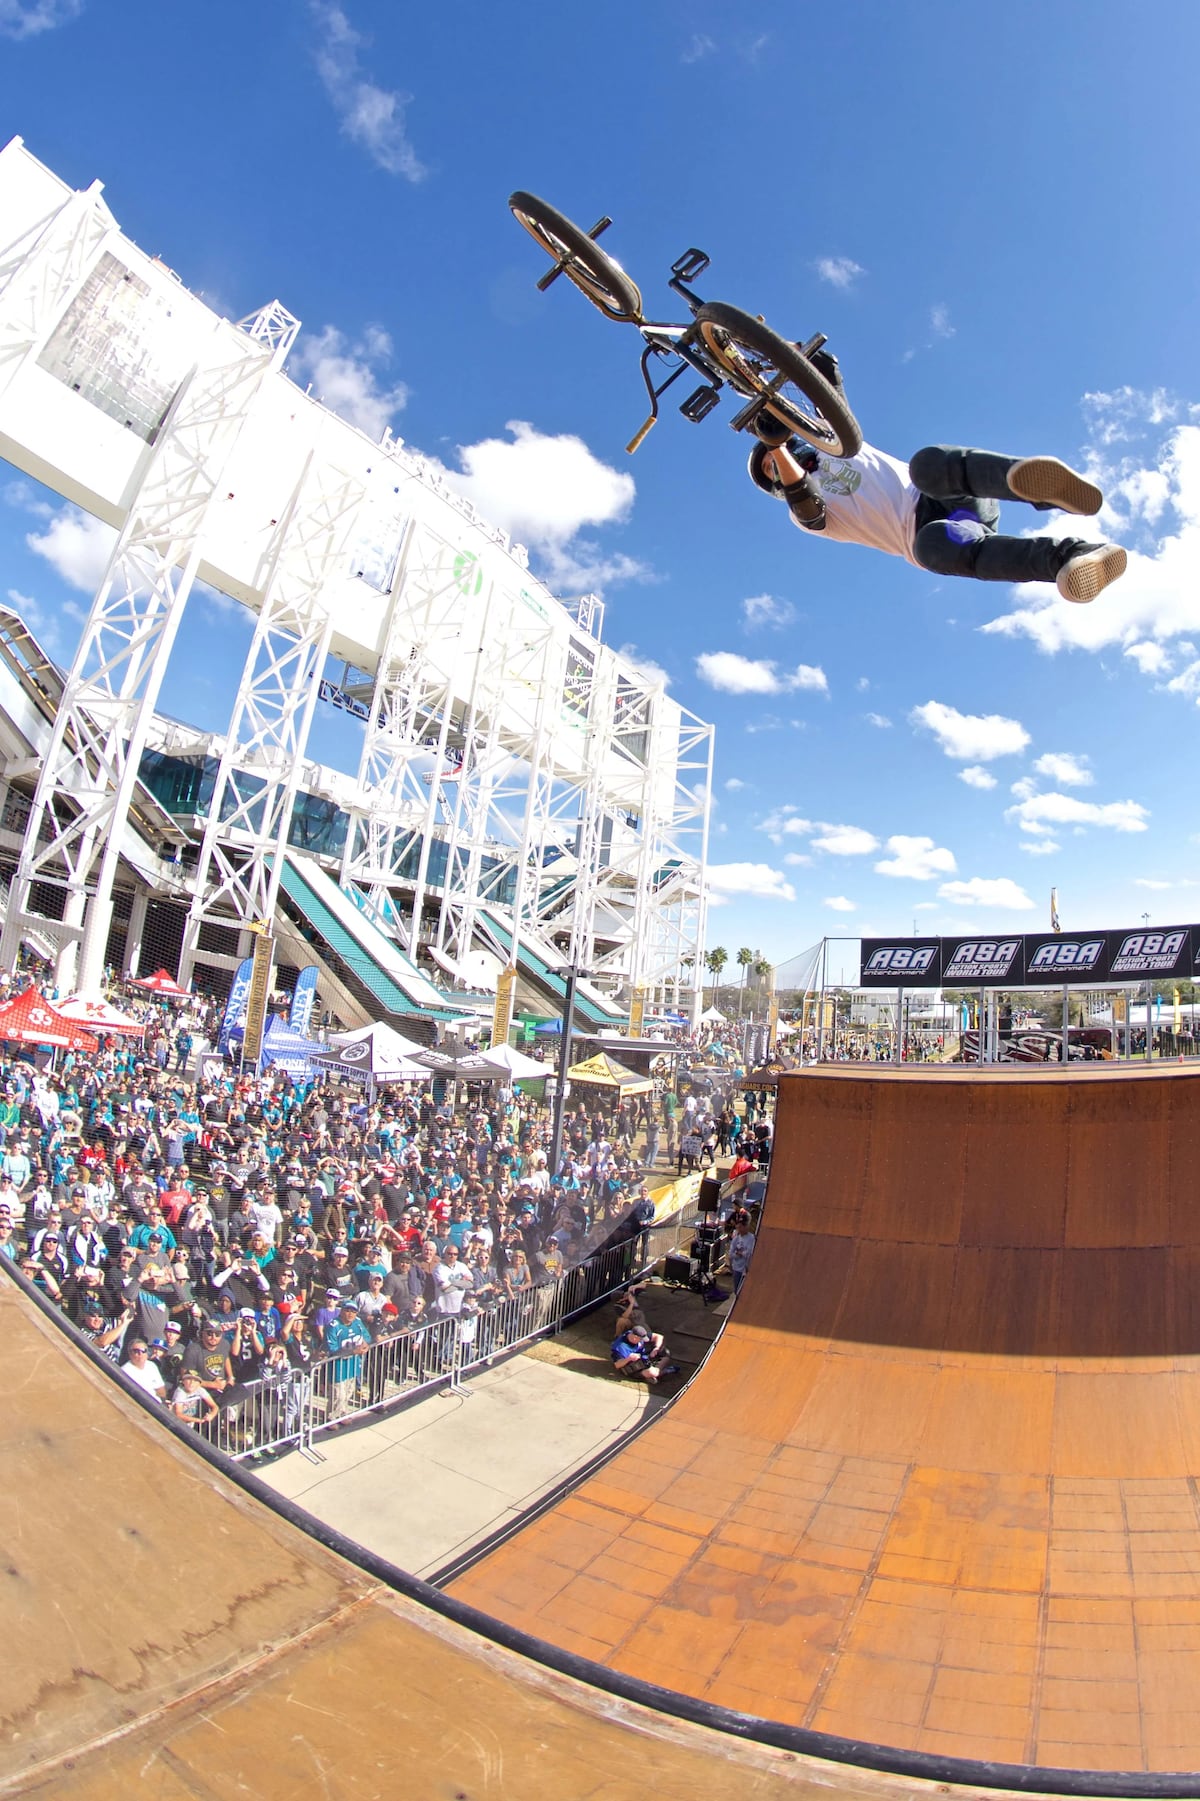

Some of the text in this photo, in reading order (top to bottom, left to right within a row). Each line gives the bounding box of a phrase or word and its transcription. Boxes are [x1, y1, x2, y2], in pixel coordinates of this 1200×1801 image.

[951, 941, 1019, 963] ASA
[1120, 932, 1183, 956] ASA
[867, 947, 936, 969] ASA
[1032, 942, 1099, 965] ASA
[1116, 954, 1177, 964] ACTION SPORTS
[947, 968, 1006, 976] WORLD TOUR
[1027, 964, 1094, 973] entertainment
[1114, 960, 1174, 971] WORLD TOUR
[249, 958, 268, 1029] ENTERTAINMENT
[242, 1342, 252, 1360] 5
[299, 1345, 310, 1361] 5
[206, 1355, 224, 1366] JAGS
